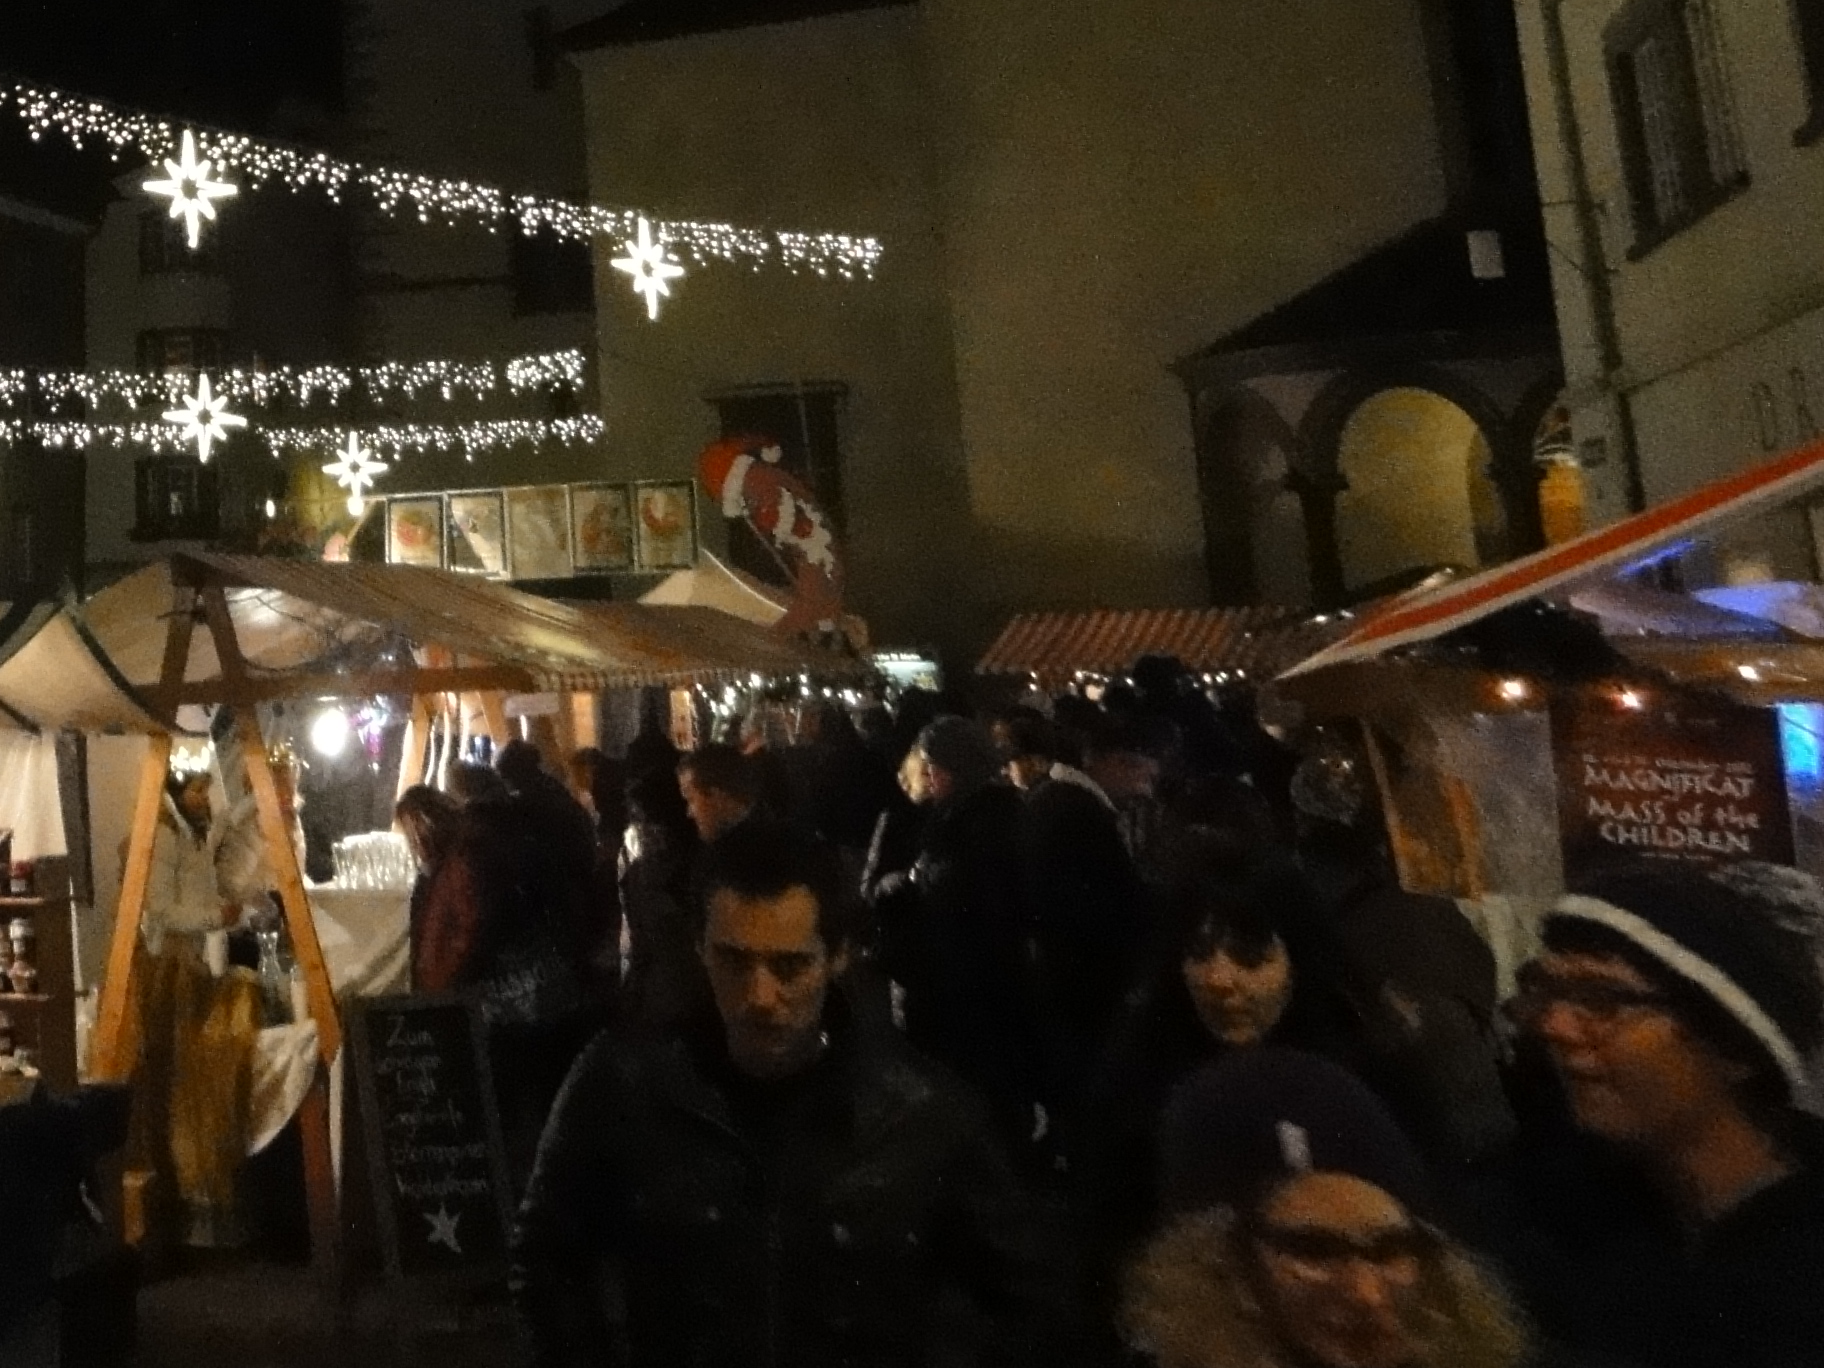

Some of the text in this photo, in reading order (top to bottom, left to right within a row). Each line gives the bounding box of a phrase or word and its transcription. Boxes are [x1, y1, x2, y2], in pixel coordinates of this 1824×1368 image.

[1588, 796, 1760, 829] MASS of the
[1599, 820, 1750, 853] CHILDREN
